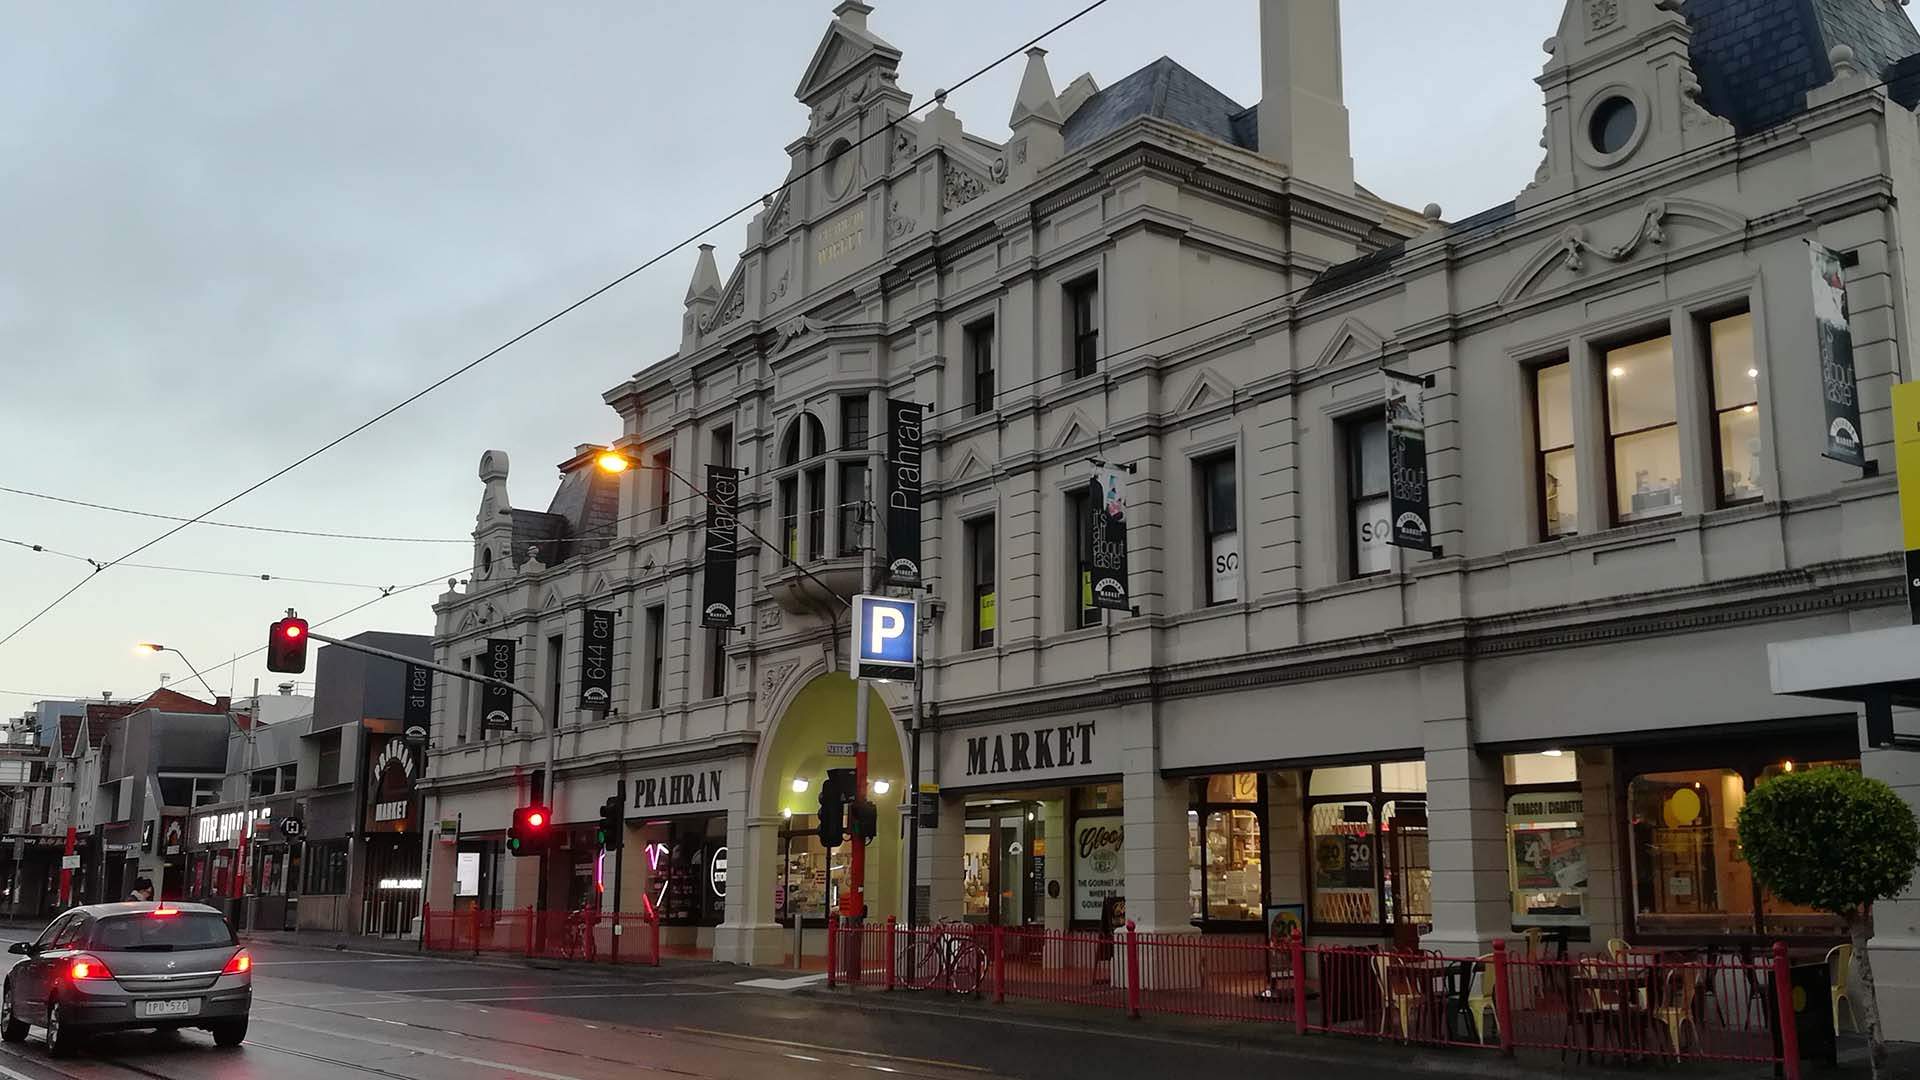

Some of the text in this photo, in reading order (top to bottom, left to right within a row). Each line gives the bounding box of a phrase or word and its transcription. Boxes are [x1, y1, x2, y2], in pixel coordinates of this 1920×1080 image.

[891, 409, 920, 511] Prahran
[708, 473, 737, 553] Market
[593, 614, 608, 639] car
[872, 606, 905, 654] P
[413, 665, 427, 694] rear
[493, 645, 509, 695] saces
[586, 645, 606, 679] 644
[410, 695, 425, 708] at
[966, 720, 1095, 776] MARKET
[634, 770, 722, 808] PRAHRAN
[375, 800, 408, 822] MARKET
[1350, 844, 1370, 861] 30
